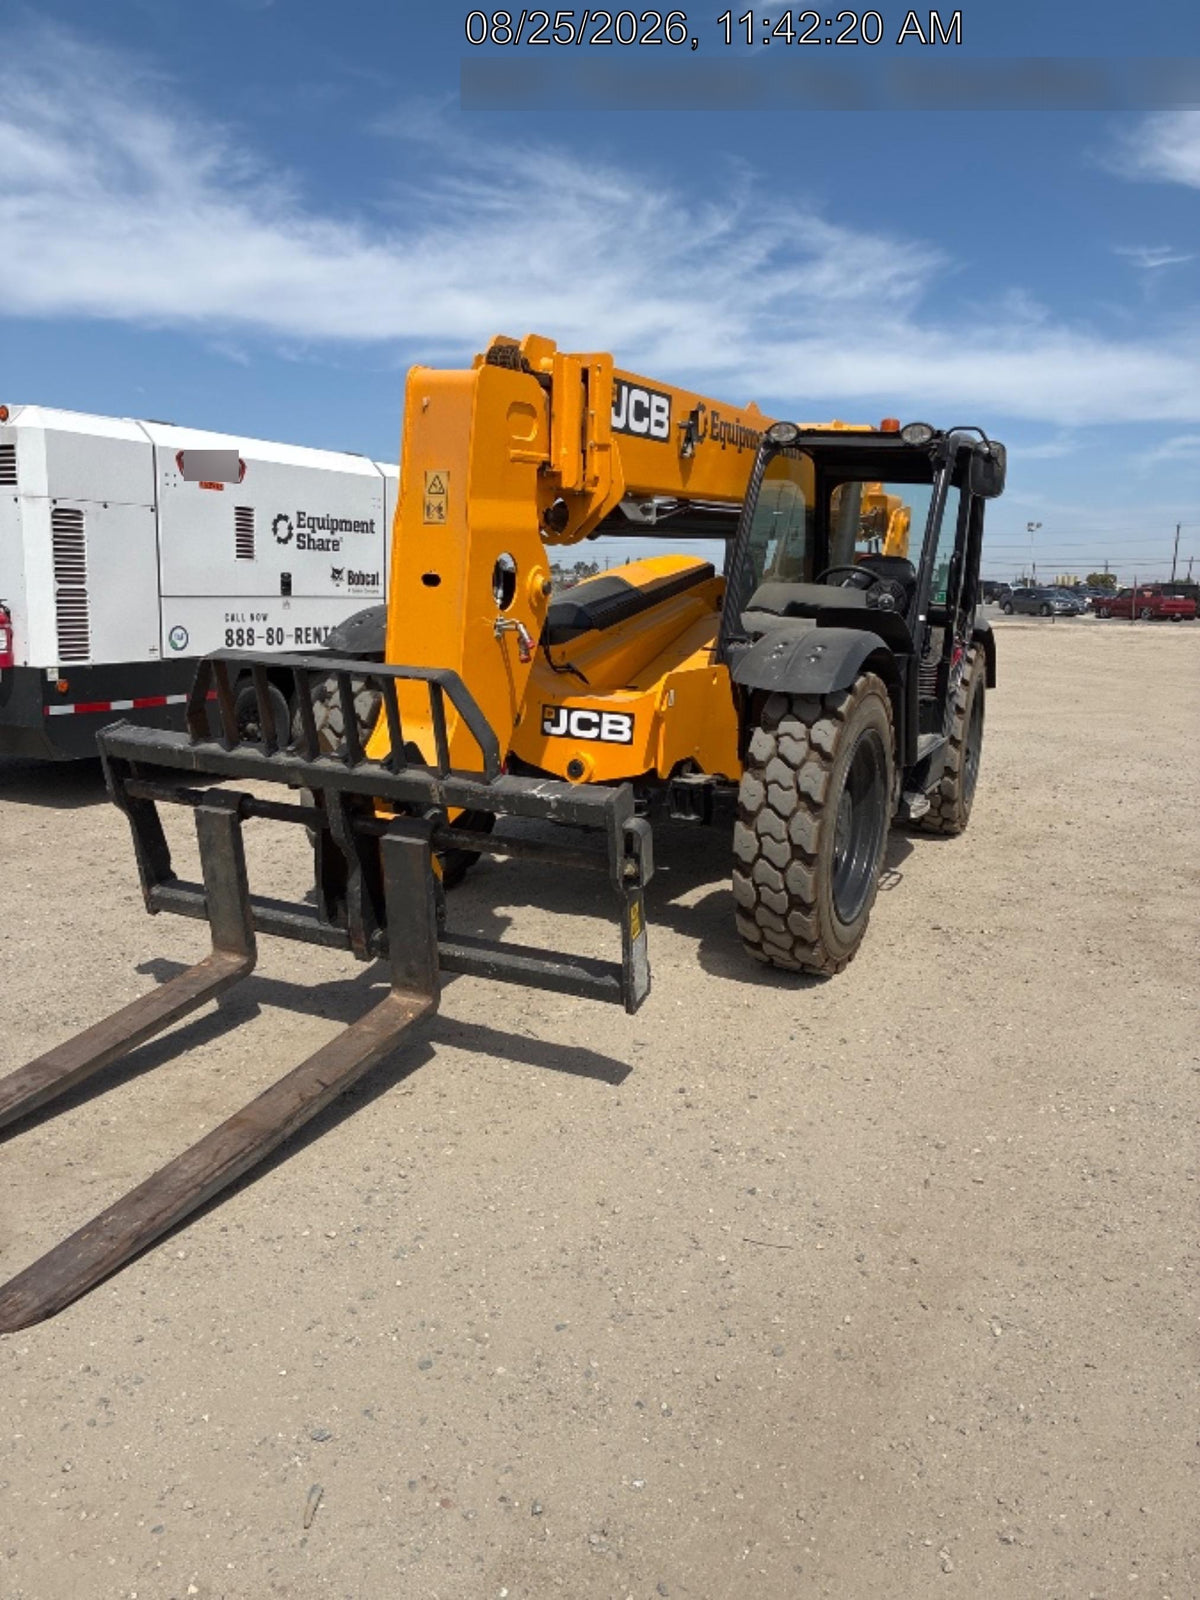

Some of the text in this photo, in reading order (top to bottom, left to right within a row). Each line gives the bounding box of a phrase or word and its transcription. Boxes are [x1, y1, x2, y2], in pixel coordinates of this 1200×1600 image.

[611, 385, 669, 438] JCB
[296, 511, 375, 535] Equipment
[296, 533, 340, 552] Share
[348, 570, 379, 586] Bobcat
[225, 613, 268, 622] CALL NOW
[225, 627, 337, 647] 888-80-RENT
[543, 708, 632, 742] JCB
